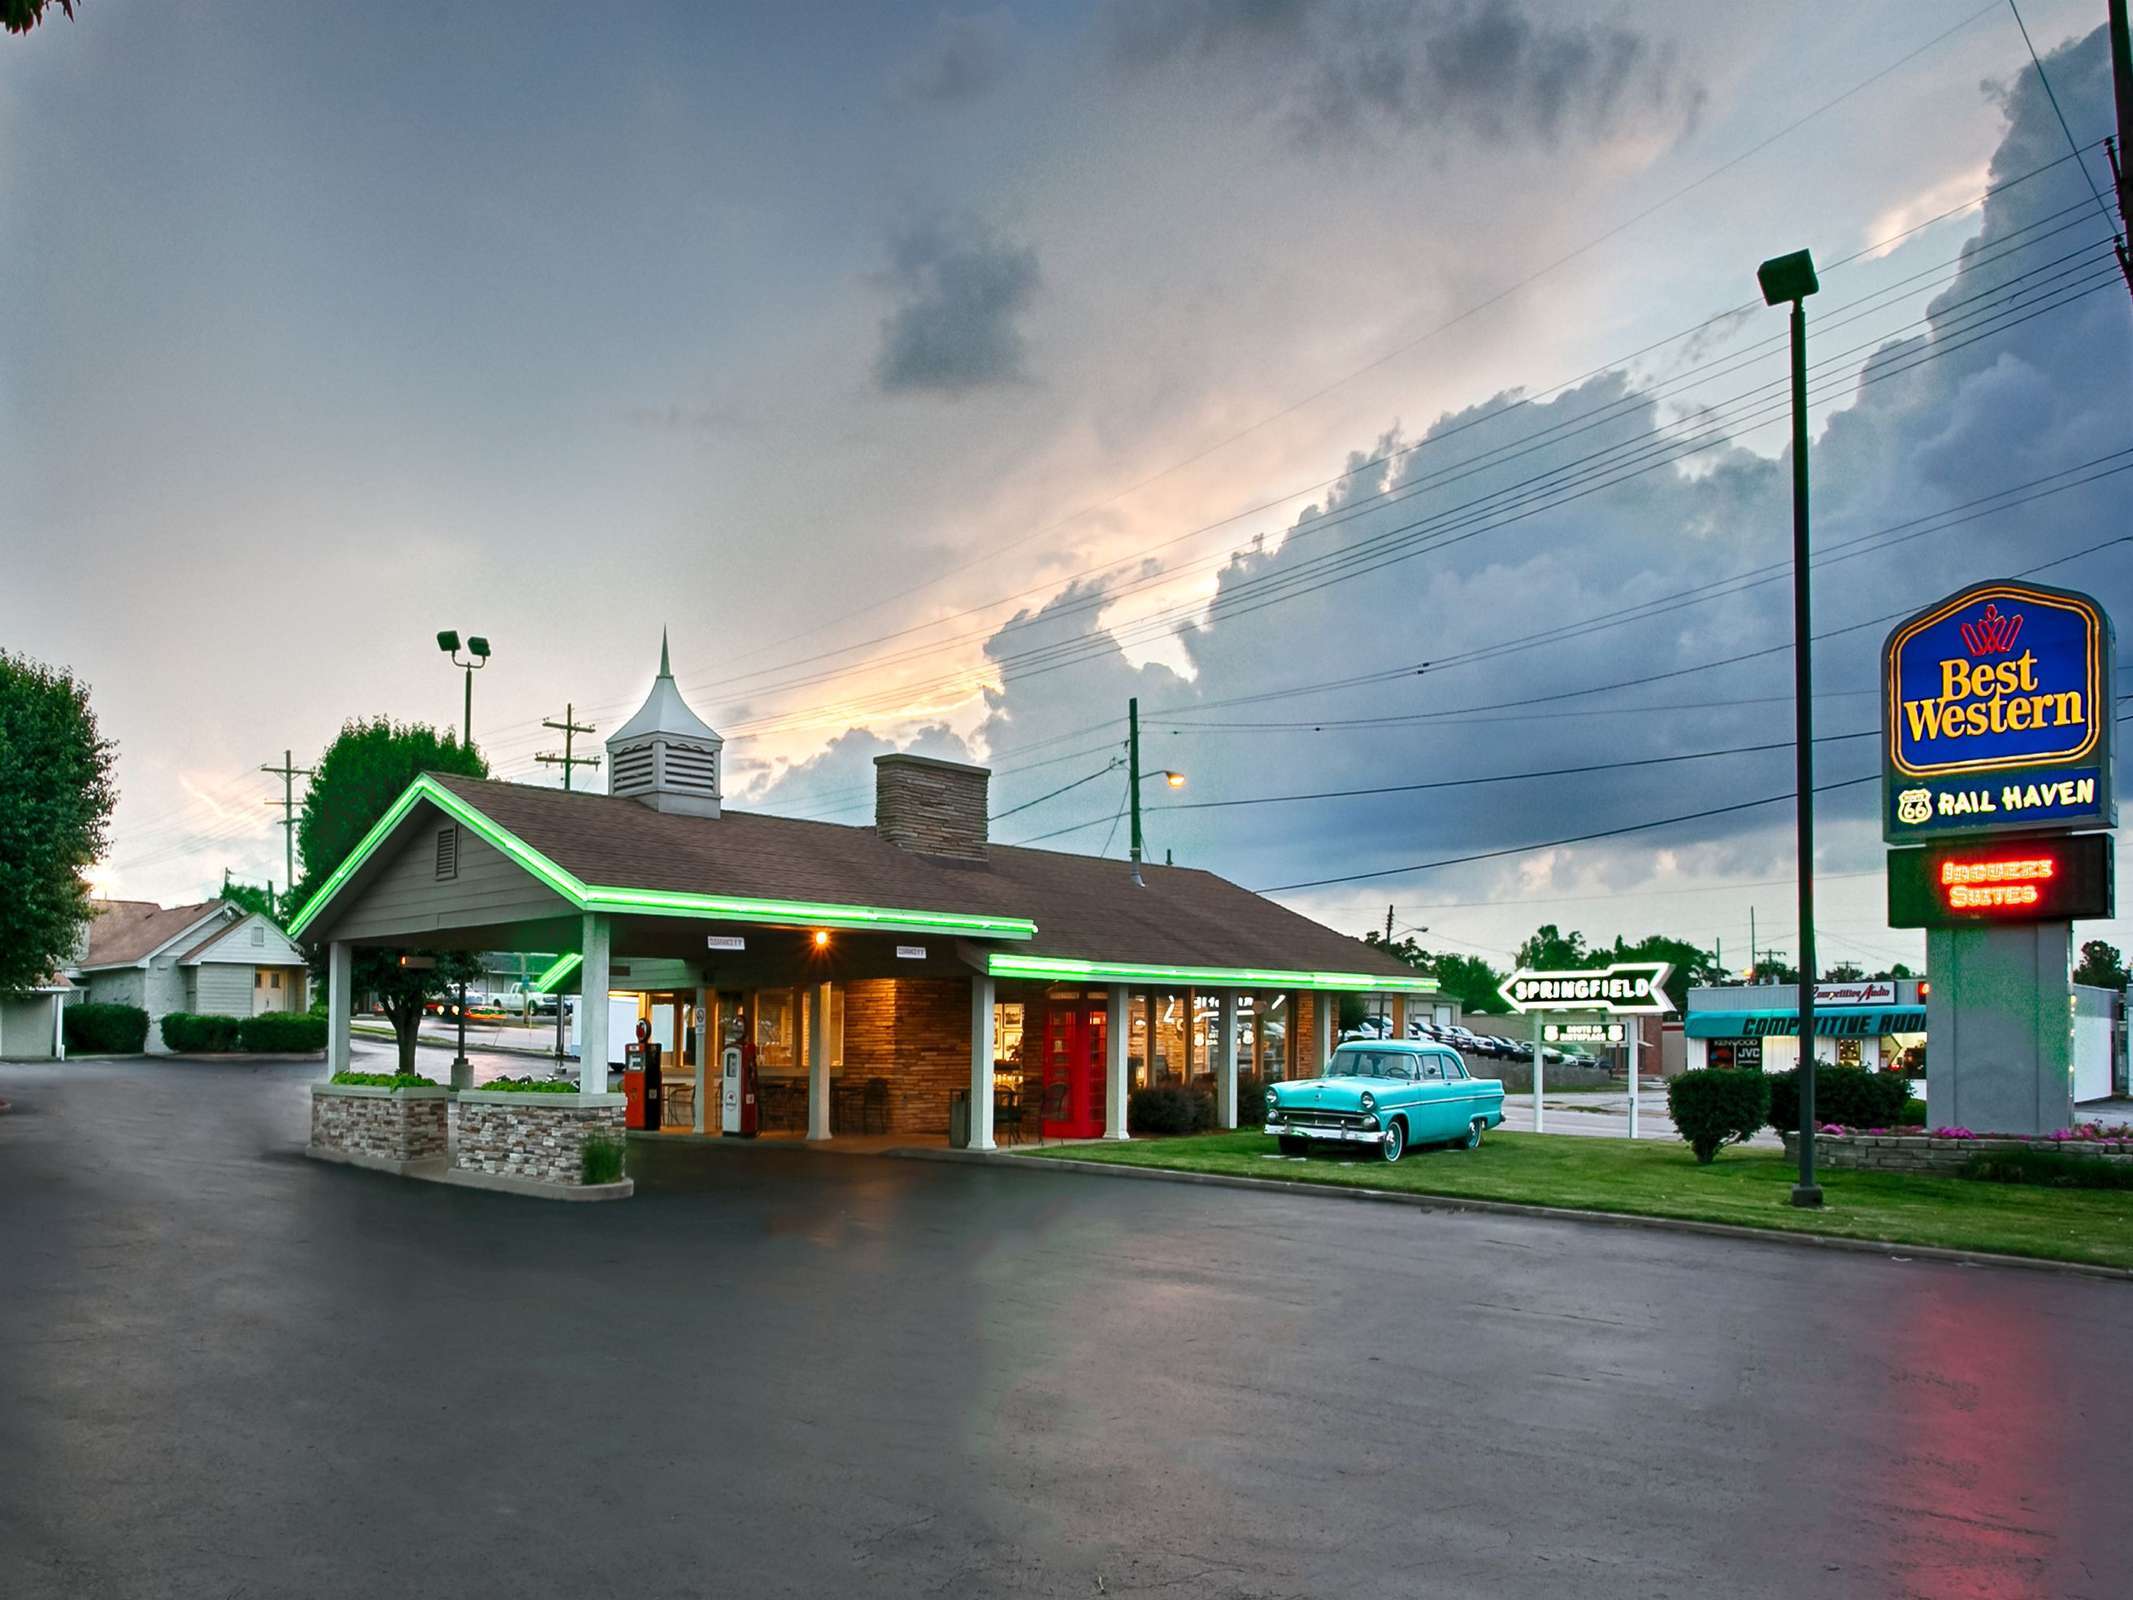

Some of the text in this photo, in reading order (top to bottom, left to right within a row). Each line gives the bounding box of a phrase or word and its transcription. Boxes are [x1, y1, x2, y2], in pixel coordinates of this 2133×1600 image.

[1940, 649, 2038, 702] Best
[1904, 691, 2085, 742] Western
[1938, 778, 2095, 816] RAIL HAVEN
[1903, 801, 1927, 819] 66
[1515, 978, 1649, 1001] SPRINGFIELD
[1742, 1013, 1927, 1036] COMPTITIVE AUDI
[1738, 1048, 1760, 1058] JVC
